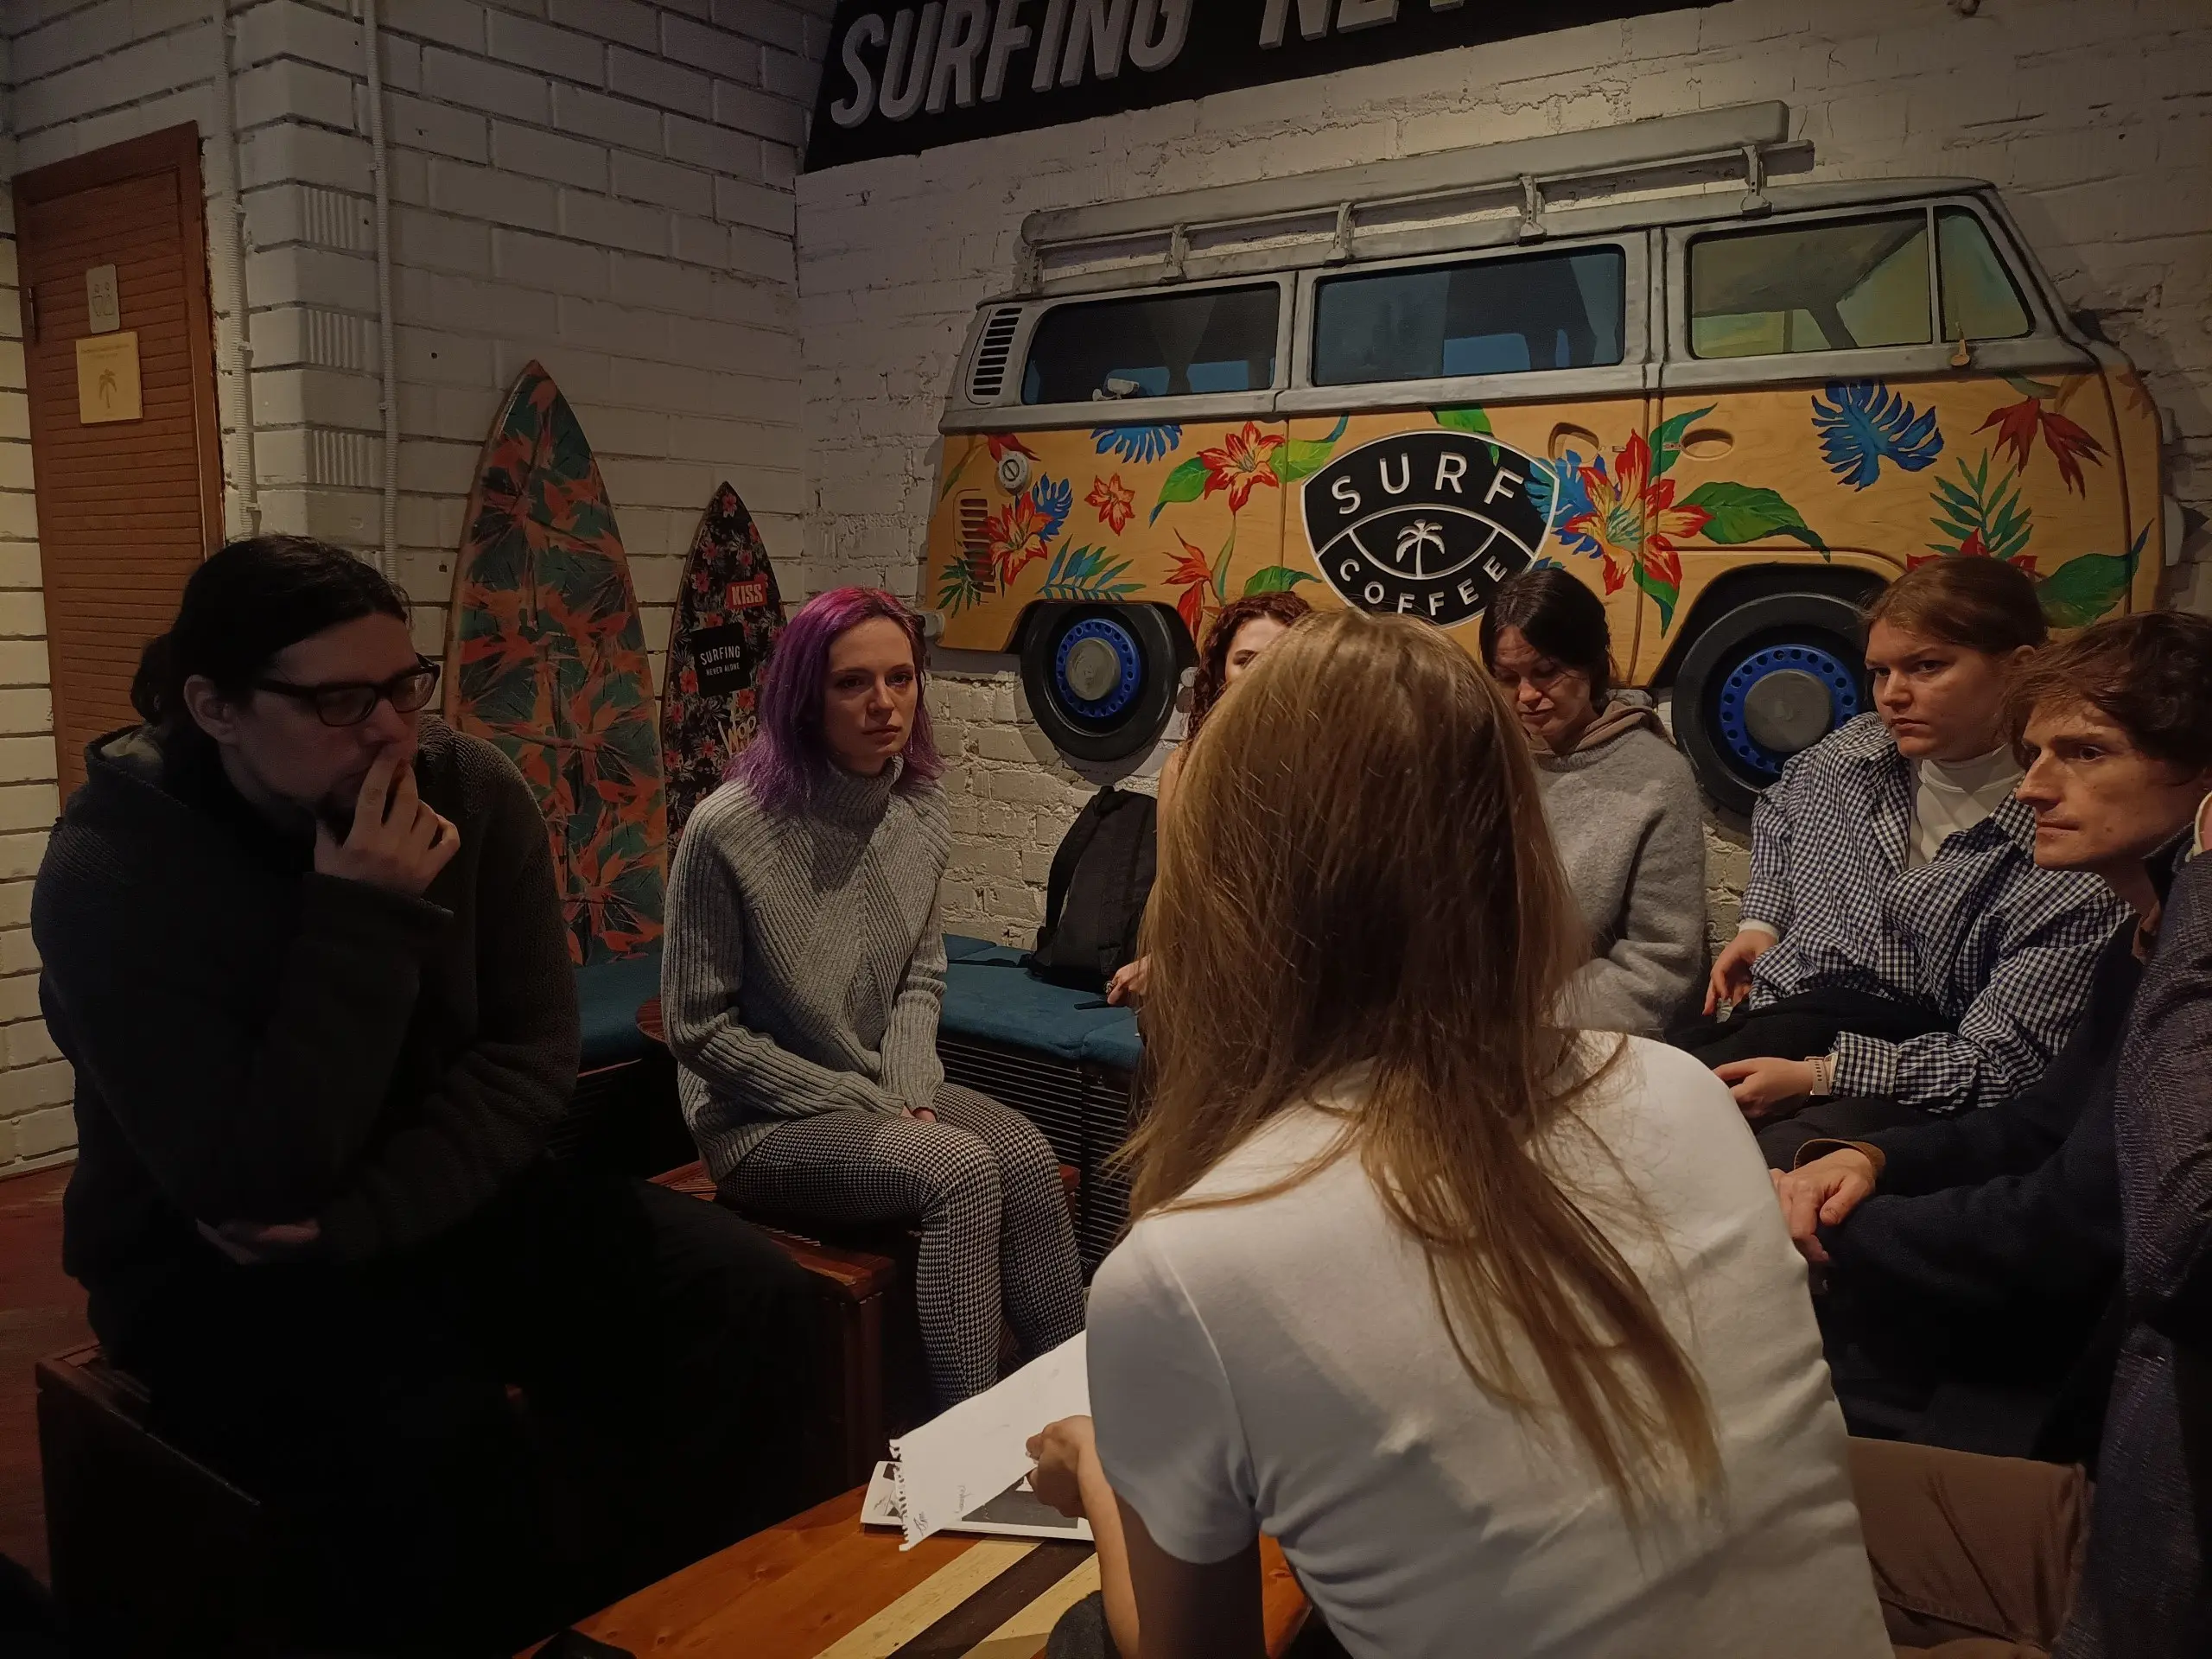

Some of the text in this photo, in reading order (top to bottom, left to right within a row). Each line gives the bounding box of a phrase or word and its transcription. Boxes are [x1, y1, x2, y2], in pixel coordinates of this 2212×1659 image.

[830, 0, 1192, 128] SURFING
[1332, 452, 1523, 515] SURF
[731, 583, 764, 606] KISS
[1340, 556, 1508, 616] COFFEE
[700, 645, 741, 666] SURFING
[705, 662, 741, 677] NEVER ALONE
